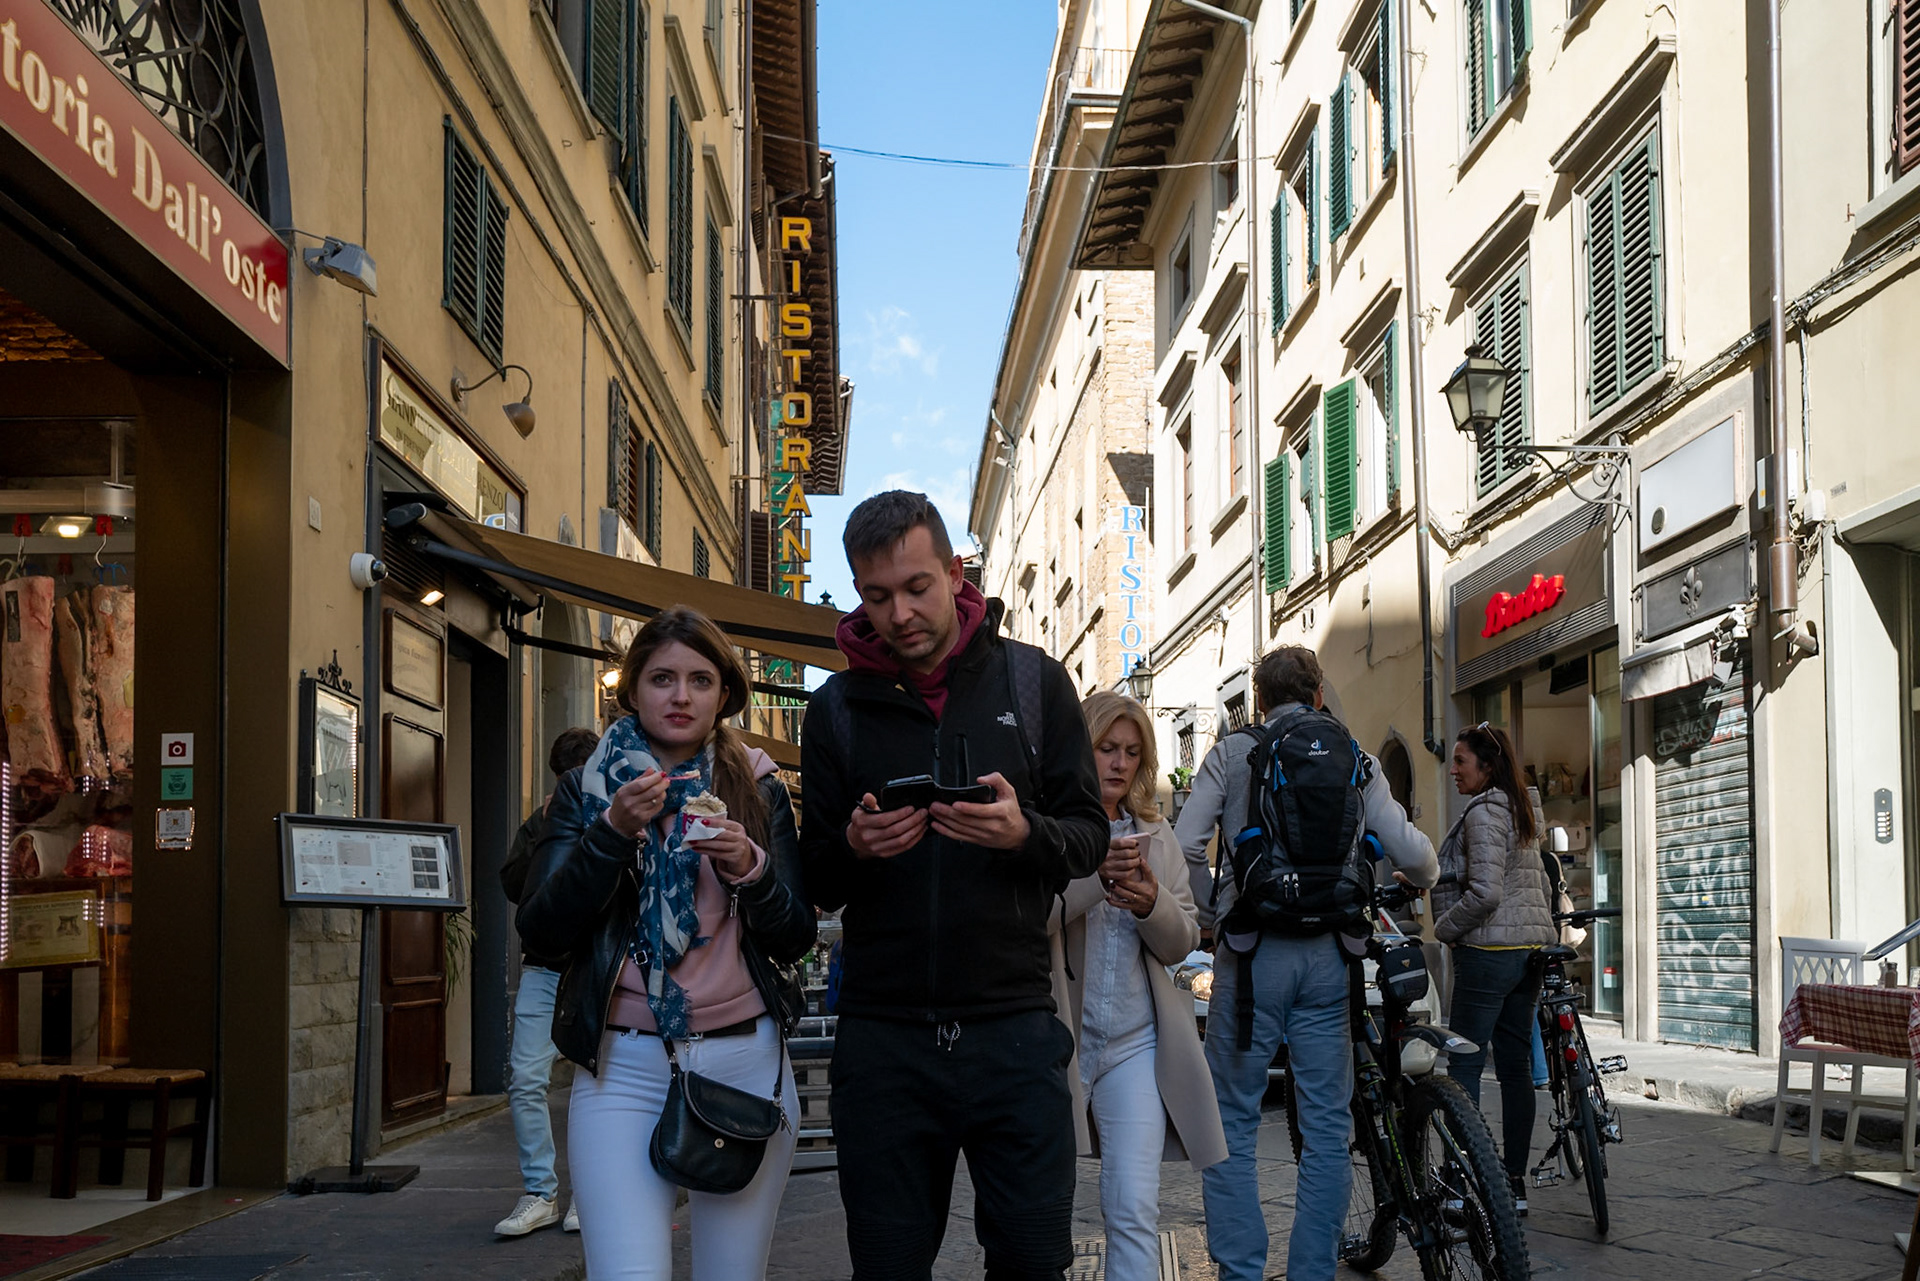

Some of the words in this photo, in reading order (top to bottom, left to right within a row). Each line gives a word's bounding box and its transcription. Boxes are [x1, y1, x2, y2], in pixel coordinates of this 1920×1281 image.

[1, 17, 118, 178] toria
[132, 125, 222, 264] Dall'
[222, 239, 282, 324] oste
